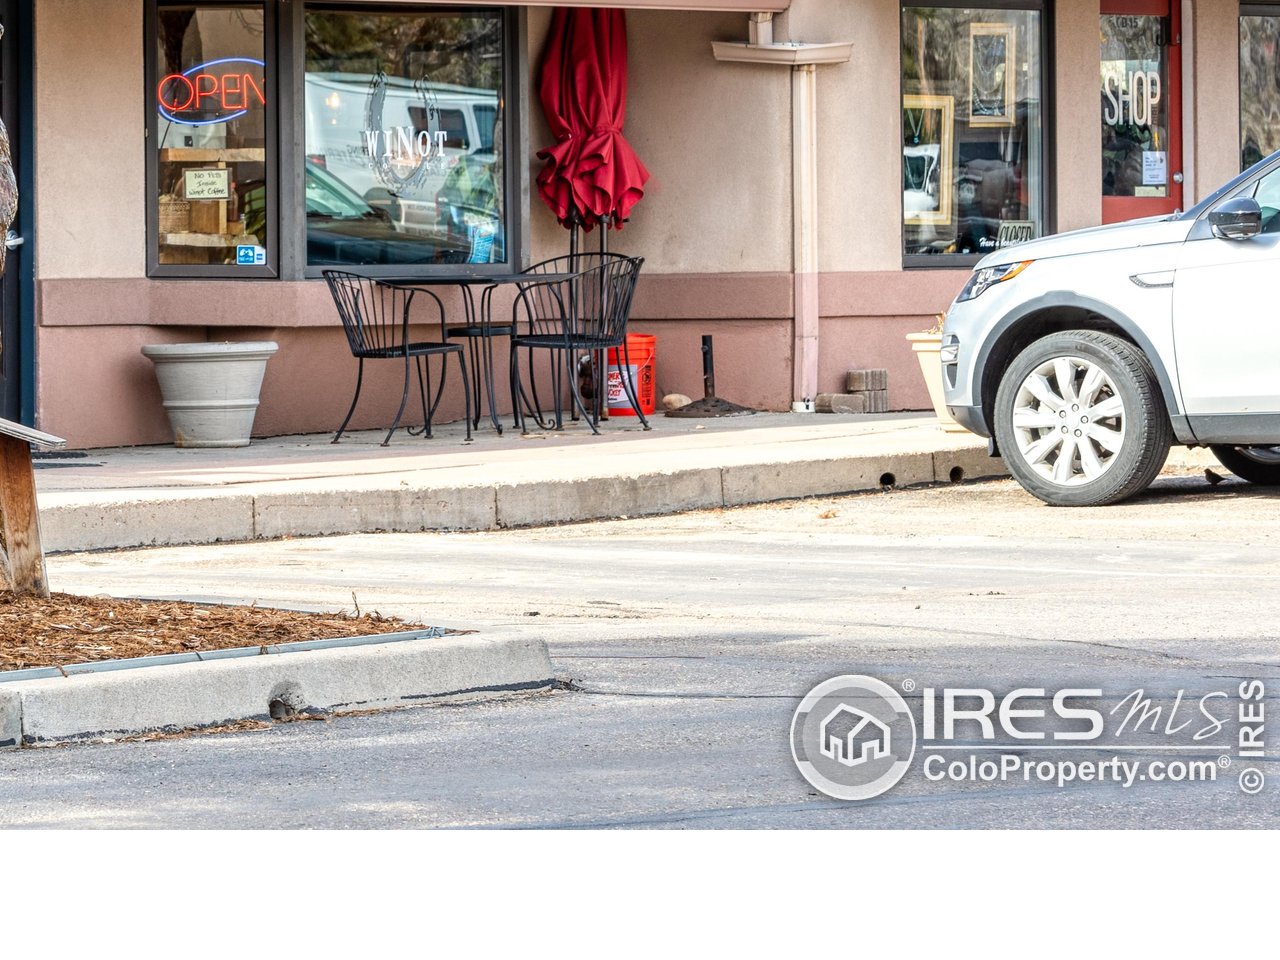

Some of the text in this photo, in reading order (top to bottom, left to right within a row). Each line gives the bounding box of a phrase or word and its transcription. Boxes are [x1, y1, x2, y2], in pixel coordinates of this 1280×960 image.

[158, 74, 265, 110] OPEN
[1104, 71, 1160, 126] SHOP
[365, 126, 448, 161] WINOT
